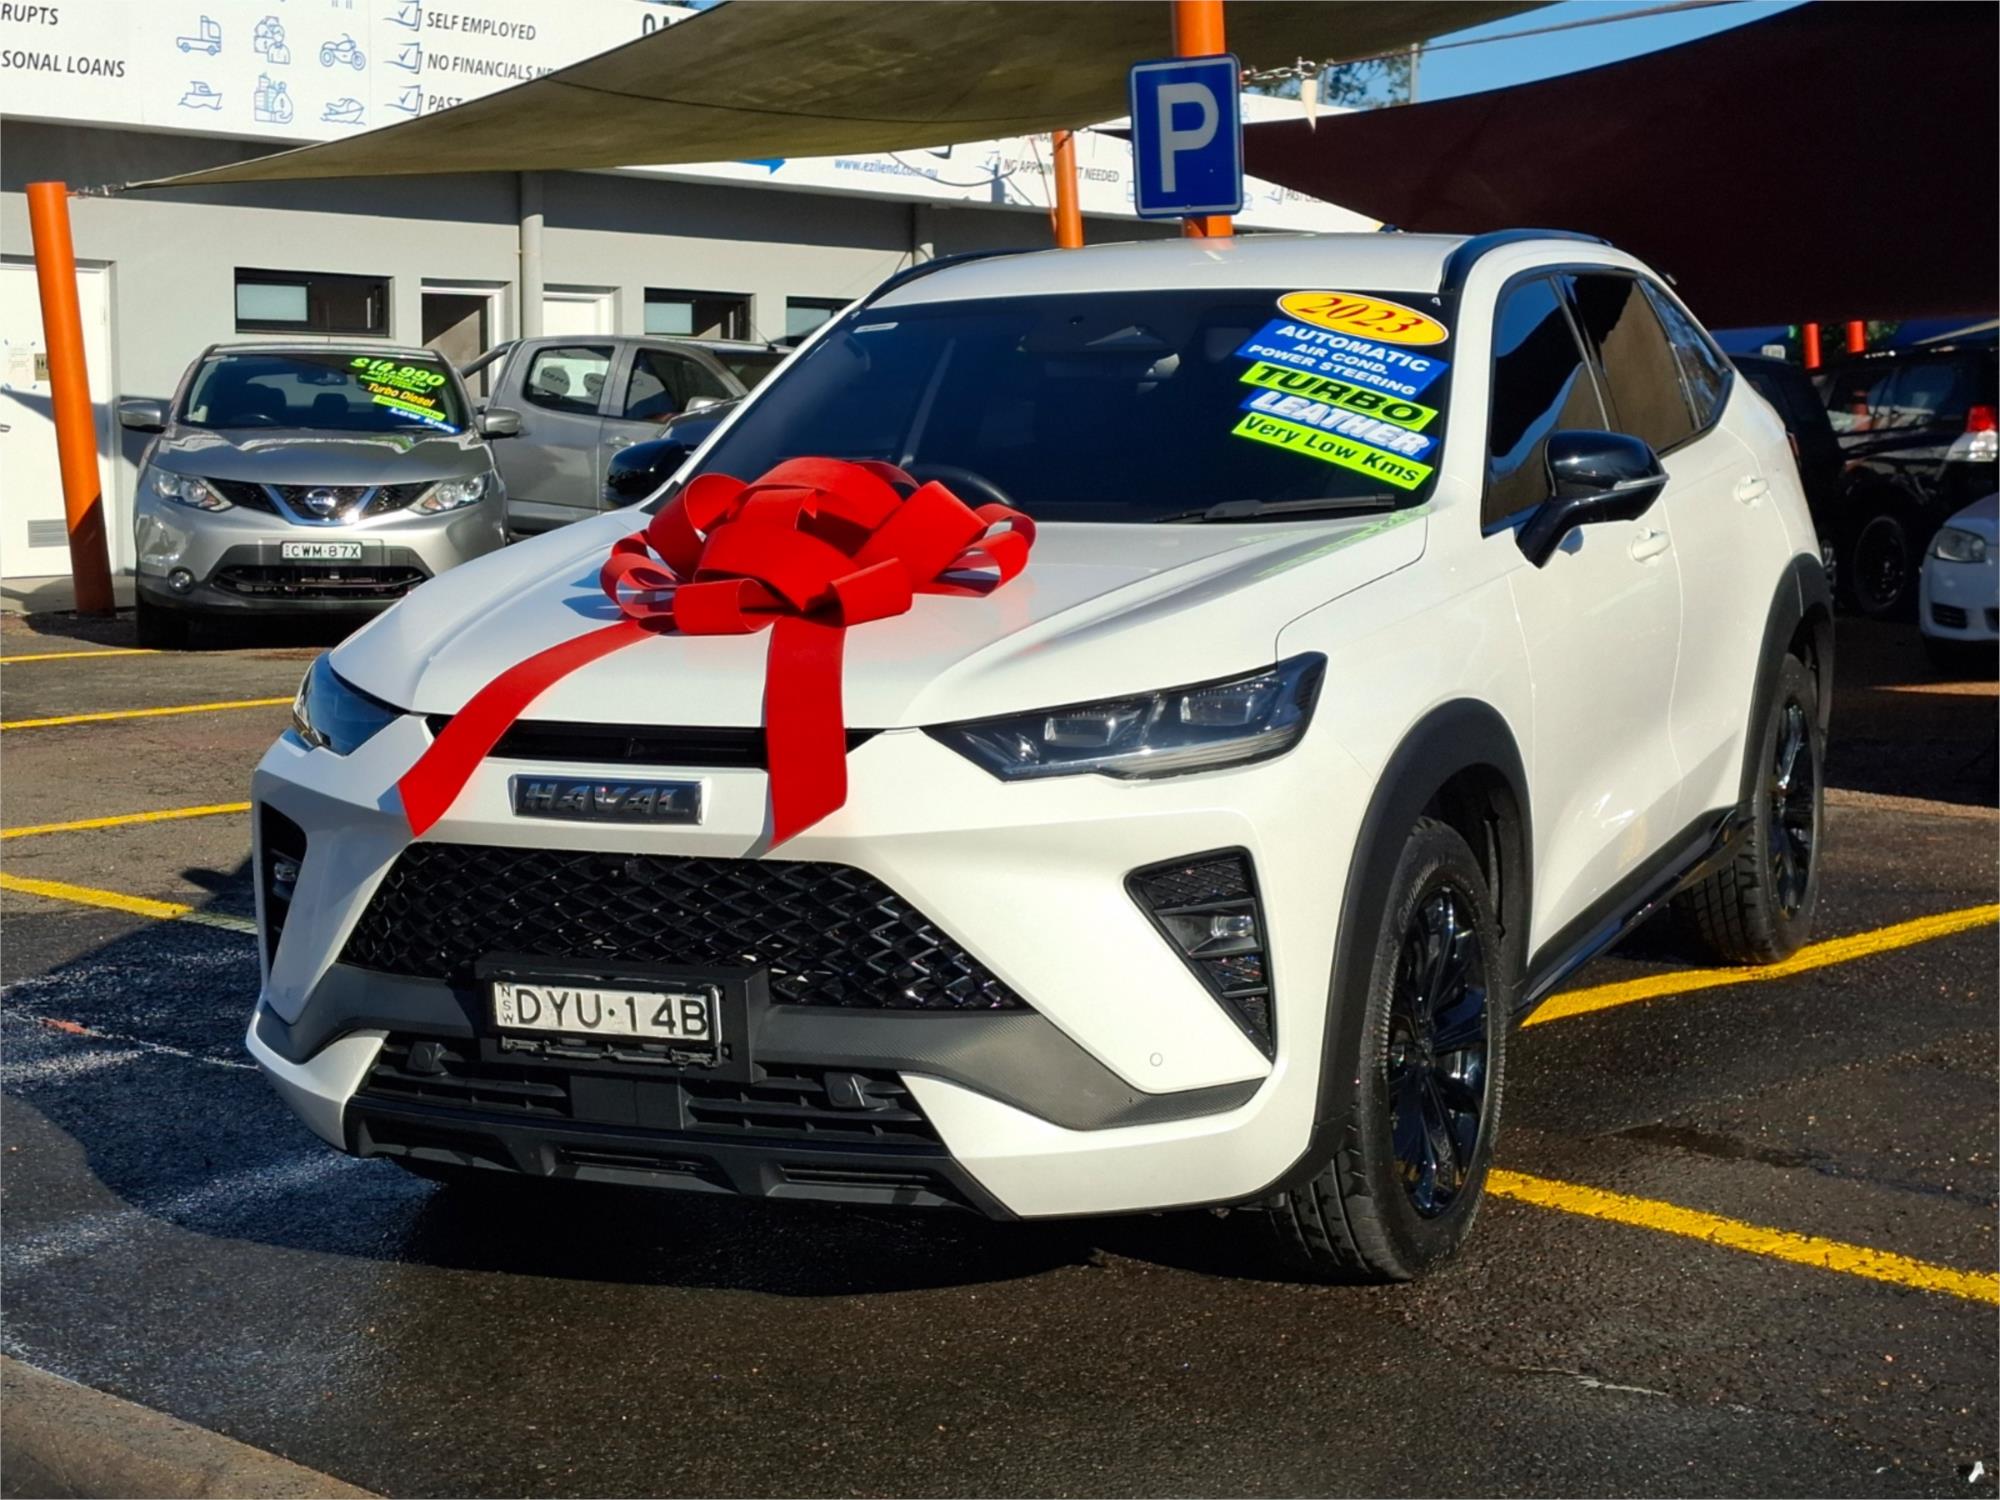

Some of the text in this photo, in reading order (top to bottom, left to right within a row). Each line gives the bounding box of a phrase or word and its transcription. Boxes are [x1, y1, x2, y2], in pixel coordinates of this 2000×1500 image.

[426, 11, 536, 41] SELF EMPLOYED
[66, 55, 125, 78] LOANS
[427, 53, 449, 71] NO
[451, 56, 533, 81] FINANCIALS
[1157, 82, 1219, 193] P
[1084, 168, 1120, 183] NEEDED
[1297, 297, 1424, 335] 2023
[1275, 325, 1431, 373] AUTOMATIC
[1293, 343, 1389, 376] AIR COND.
[1247, 344, 1417, 396] POWER STEERING
[367, 383, 400, 397] Turbo
[400, 391, 436, 407] Diesel
[1256, 365, 1426, 423] TURBO
[1249, 390, 1431, 457] LEATHER
[1244, 416, 1420, 482] Very Low Kms
[525, 783, 691, 814] HAVAL
